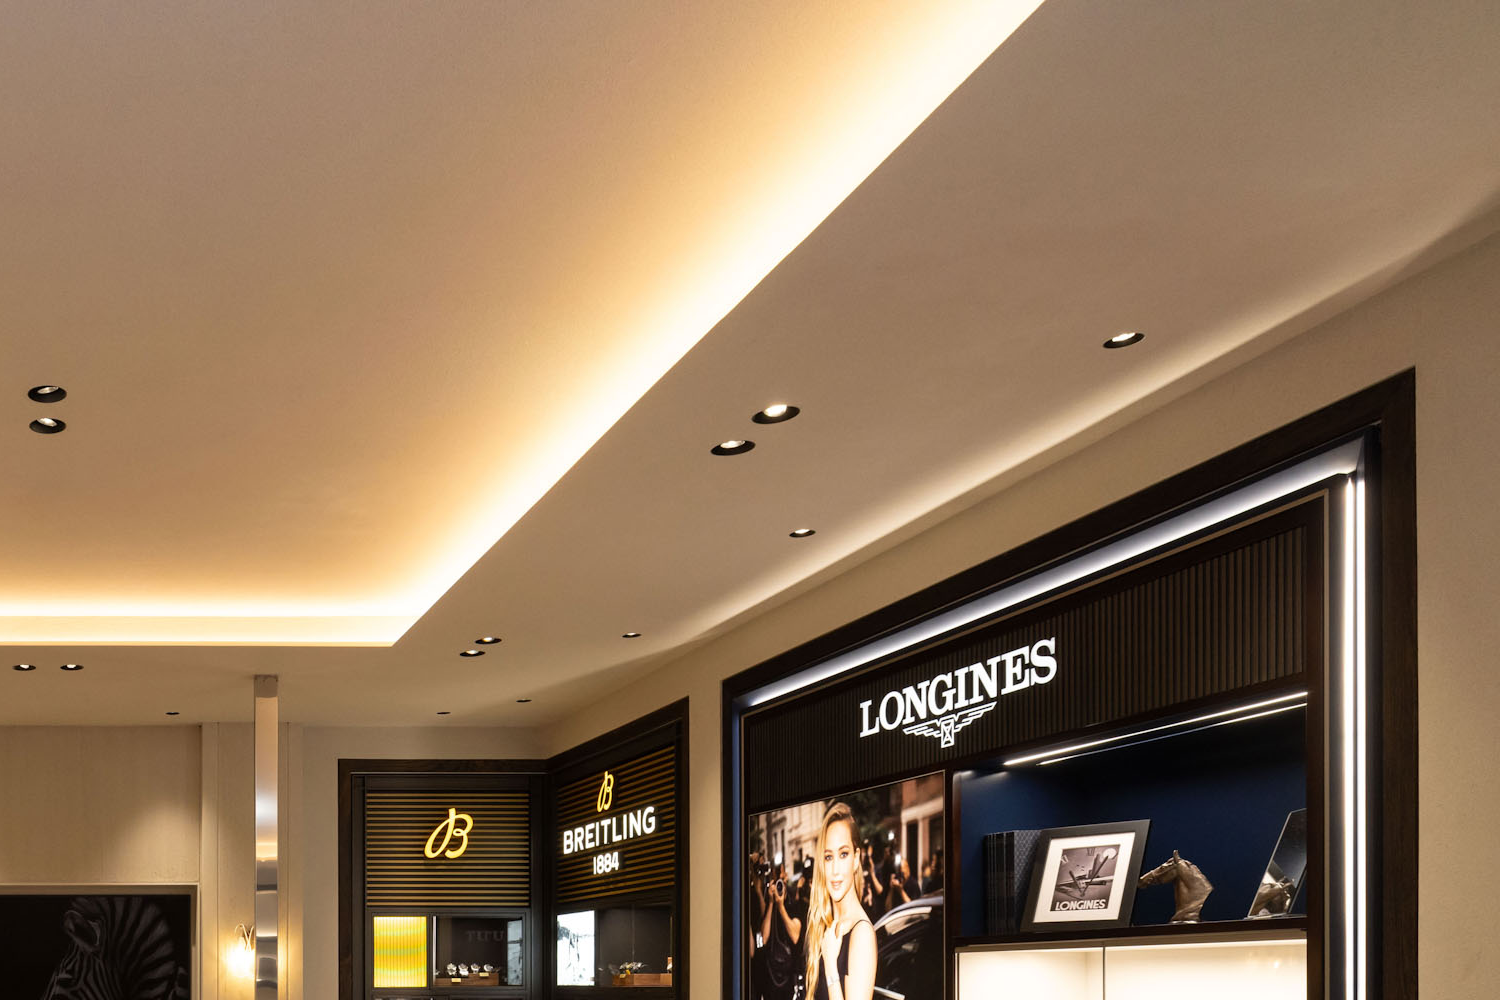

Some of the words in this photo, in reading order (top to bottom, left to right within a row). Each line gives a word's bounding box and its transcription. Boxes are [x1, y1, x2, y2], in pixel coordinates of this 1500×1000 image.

[859, 636, 1058, 738] LONGINES
[563, 806, 656, 855] BREITLING
[592, 851, 620, 875] 1884
[1055, 899, 1106, 911] LONGINES
